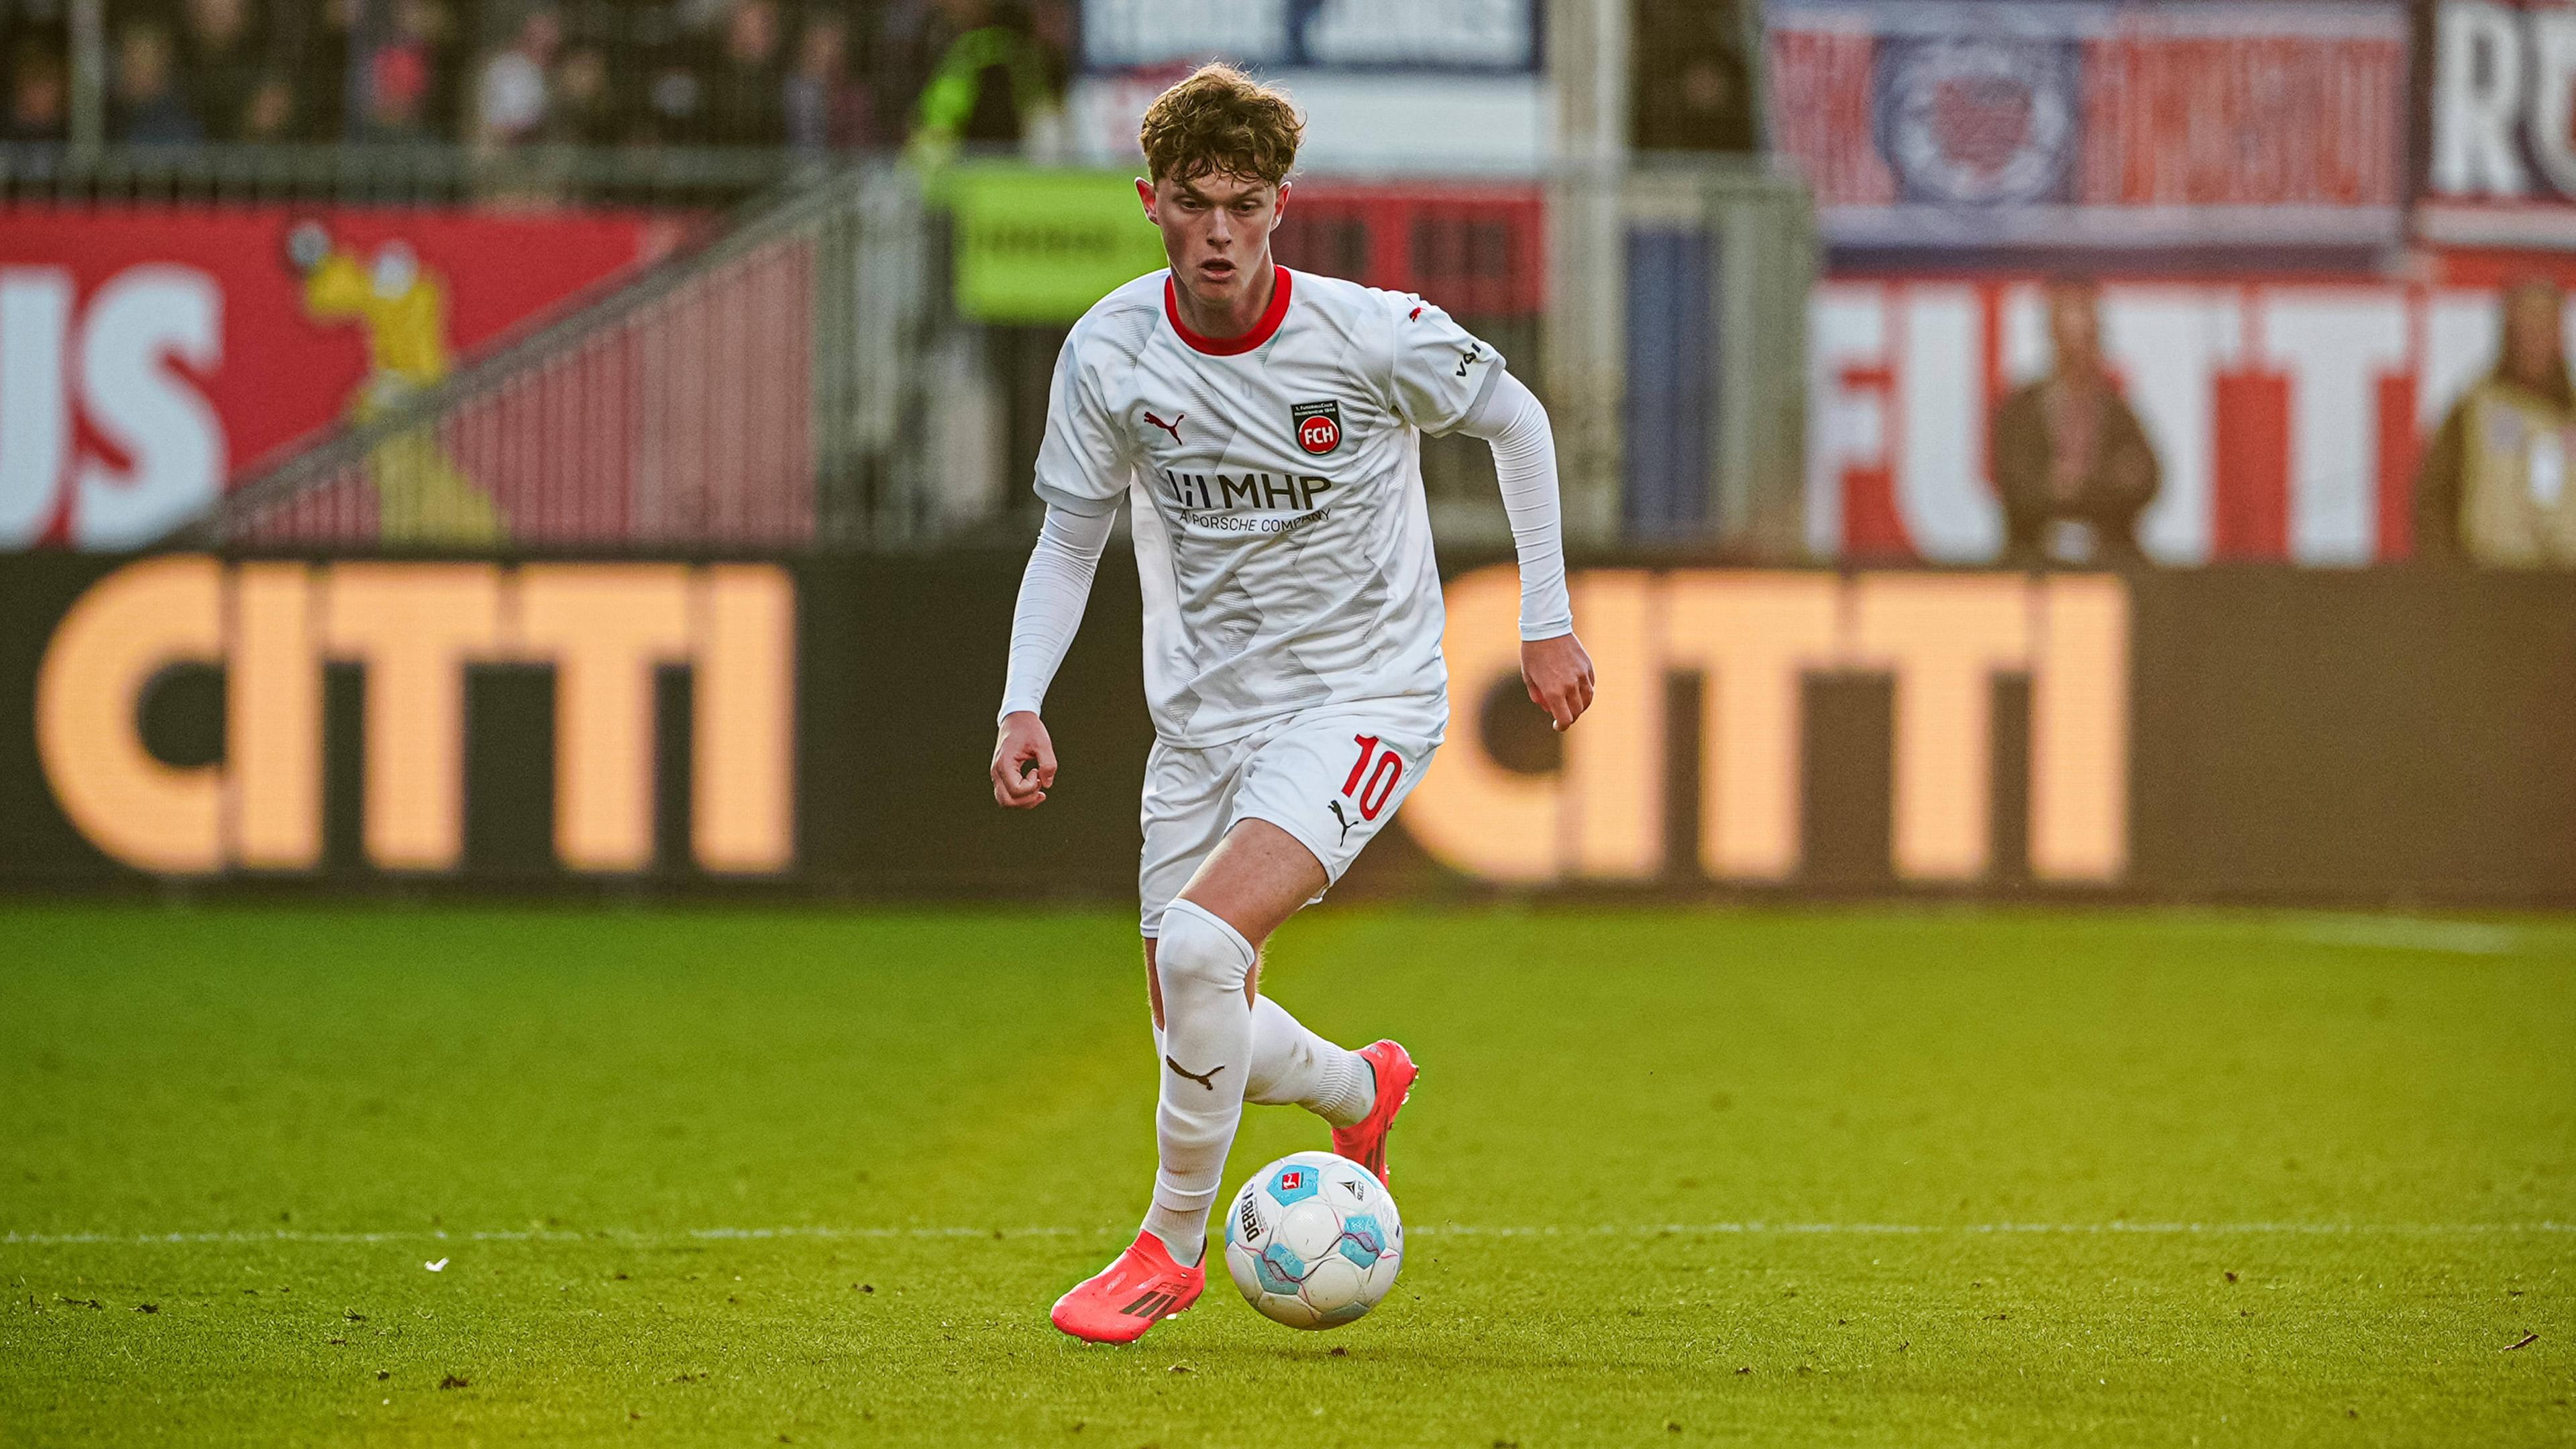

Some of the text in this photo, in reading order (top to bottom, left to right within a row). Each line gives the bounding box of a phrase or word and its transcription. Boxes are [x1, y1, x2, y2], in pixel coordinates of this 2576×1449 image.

[1304, 425, 1334, 445] FCH
[1179, 508, 1332, 532] A PORSCHE COMPANY
[1217, 474, 1332, 510] MHP
[35, 553, 796, 872] CITTI
[1398, 565, 2129, 880] CITTI
[1341, 734, 1403, 821] 10
